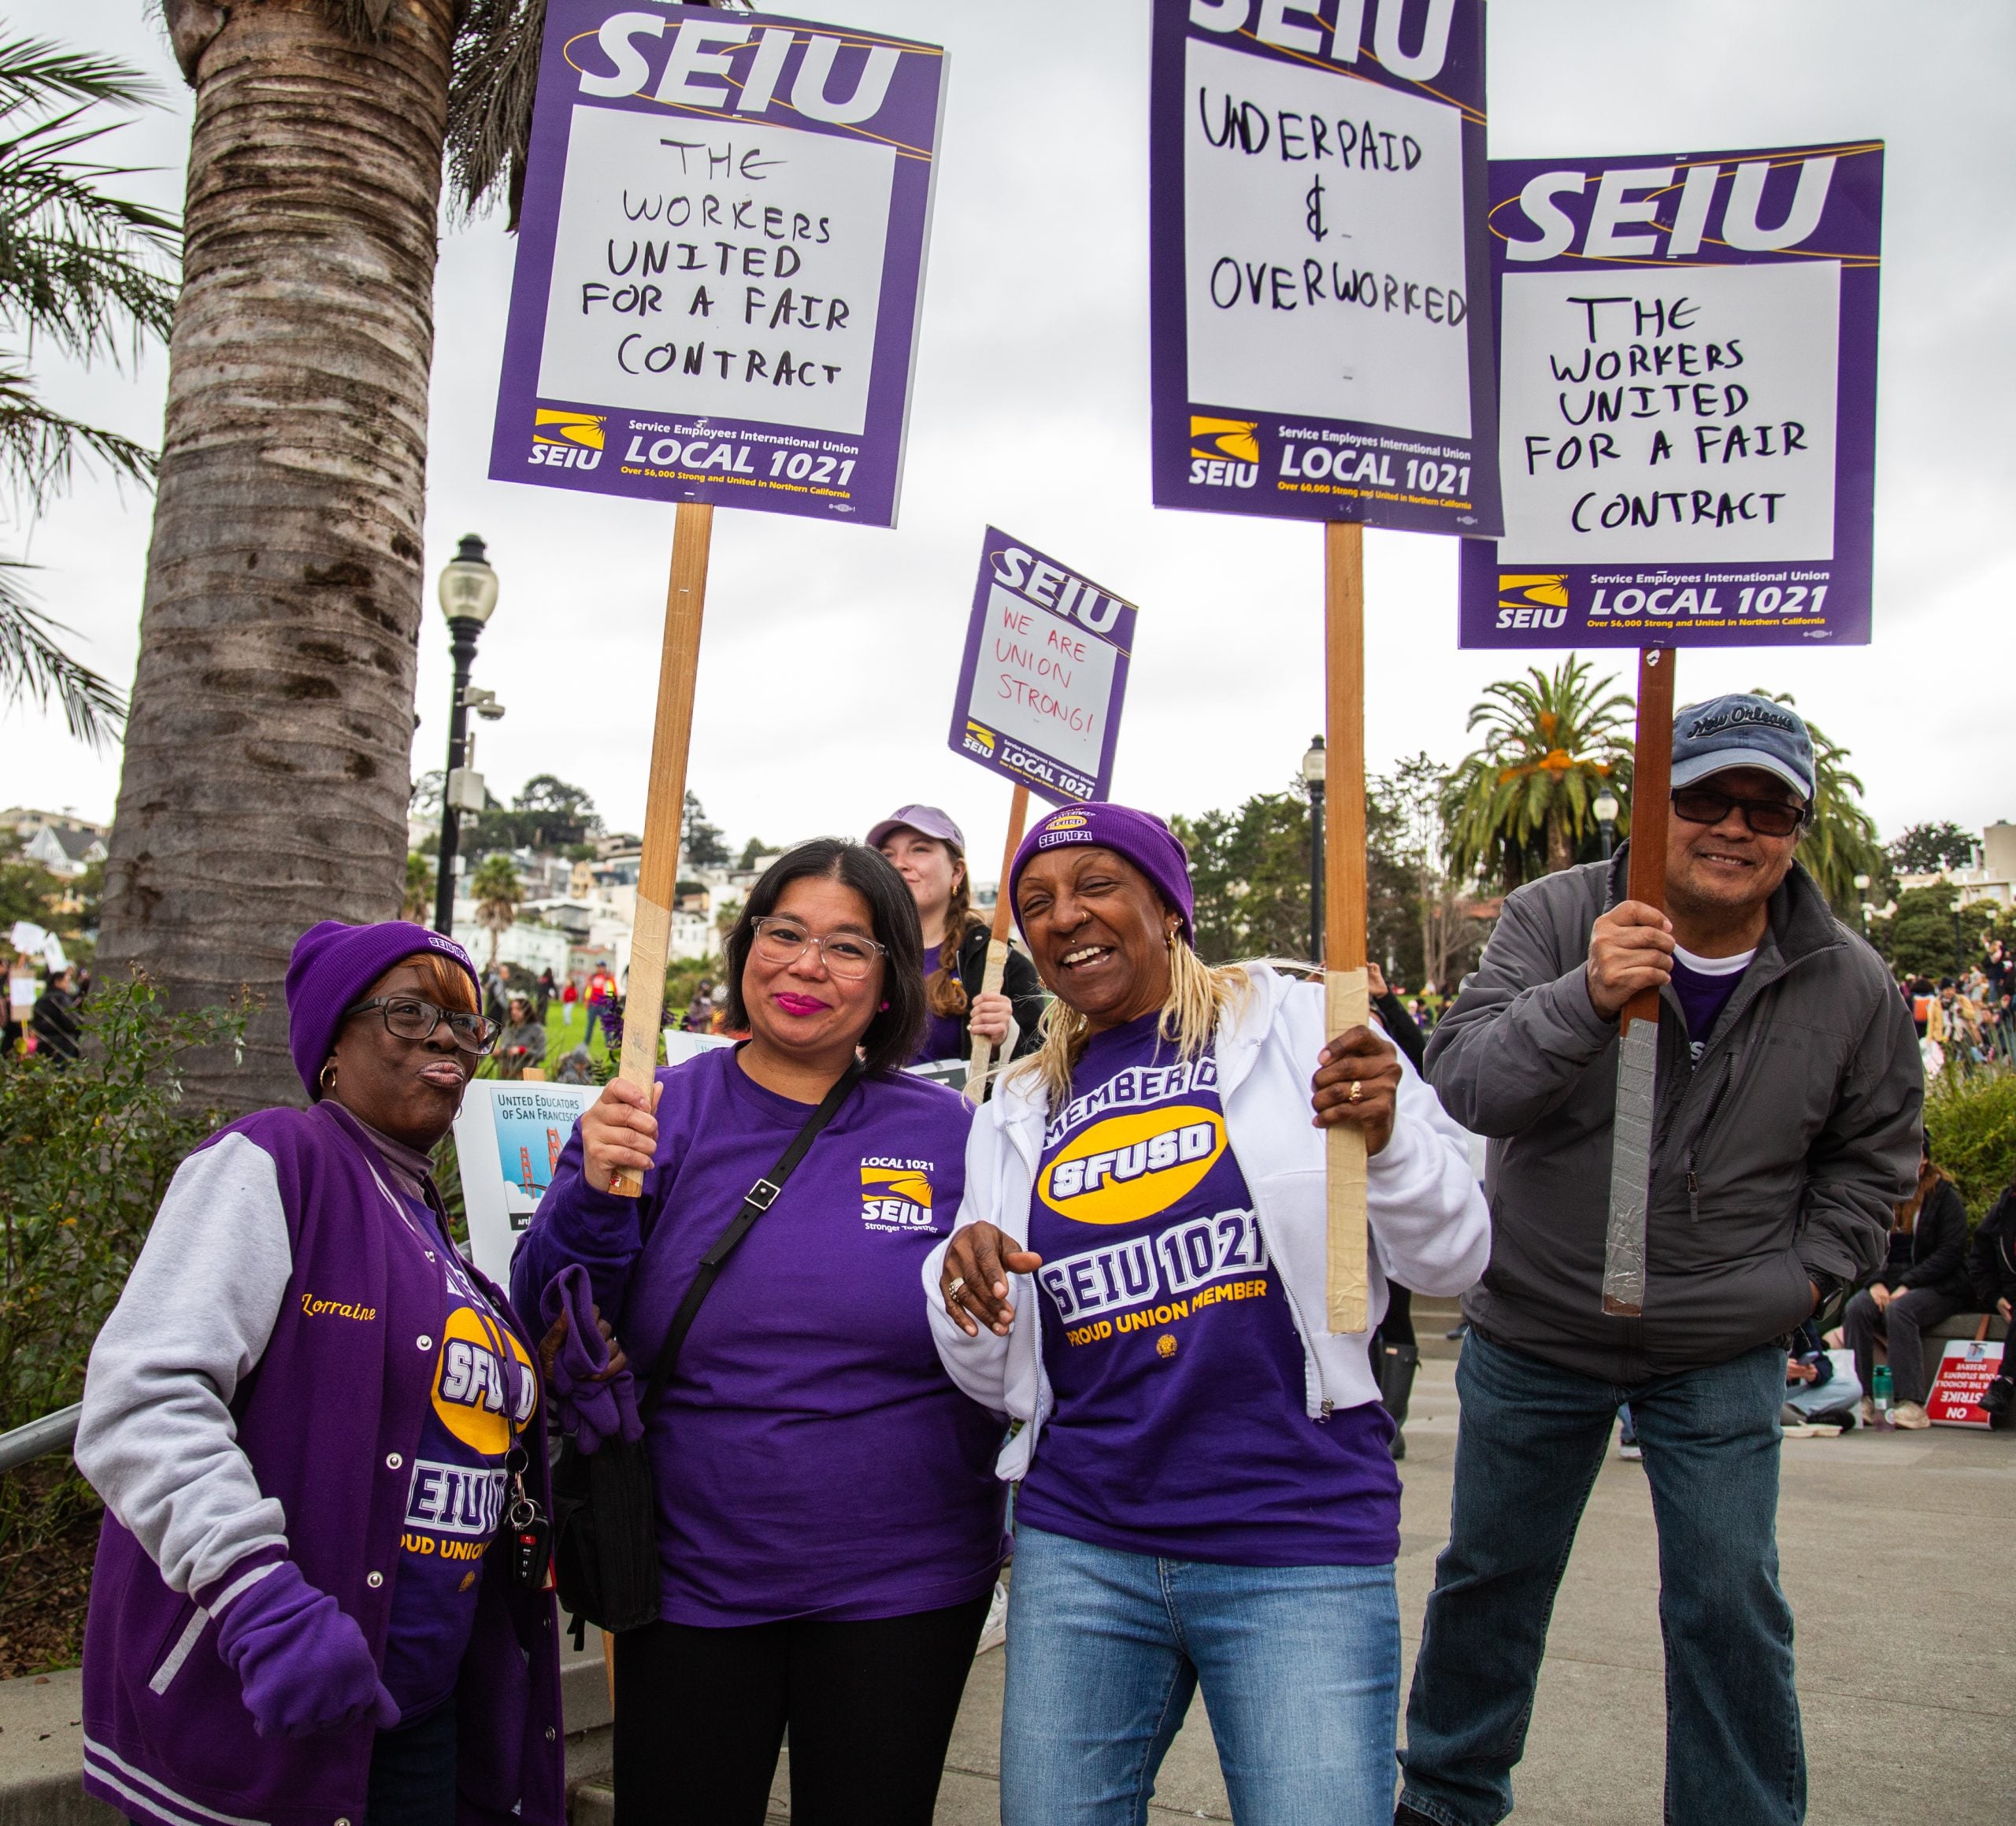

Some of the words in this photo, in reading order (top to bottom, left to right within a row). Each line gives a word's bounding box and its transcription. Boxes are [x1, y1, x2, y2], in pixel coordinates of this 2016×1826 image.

[578, 12, 901, 124] SEIU
[1200, 87, 1421, 171] UNDERPAID
[660, 138, 789, 180] THE
[624, 189, 829, 243] WORKERS
[1506, 156, 1837, 261] SEIU
[607, 239, 800, 278] UNITED
[582, 282, 662, 317] FOR
[688, 284, 714, 317] A
[745, 287, 850, 331] FAIR
[1211, 257, 1467, 326] OVERWORKED
[1566, 296, 1701, 343] THE
[618, 333, 842, 387] CONTRACT
[1550, 339, 1744, 383] WORKERS
[1559, 383, 1749, 425] UNITED
[528, 444, 602, 470] SEIU
[629, 420, 670, 433] Service
[674, 424, 737, 439] Employees
[740, 431, 819, 449] International
[822, 442, 859, 455] Union
[1278, 425, 1319, 440] Service
[1322, 430, 1378, 447] Employees
[1380, 437, 1440, 456] International
[1443, 446, 1471, 461] Union
[1525, 431, 1621, 475] FOR
[1649, 430, 1673, 465] A
[1694, 421, 1808, 465] FAIR
[624, 435, 756, 473] LOCAL
[769, 450, 856, 486] 1021
[1188, 458, 1258, 488] SEIU
[1279, 444, 1395, 487] LOCAL
[1406, 459, 1470, 495] 1021
[621, 466, 642, 476] Over
[644, 468, 675, 479] 56,000
[677, 472, 705, 483] Strong
[707, 475, 724, 483] and
[727, 476, 756, 487] United
[758, 480, 767, 488] in
[769, 481, 807, 493] Northern
[810, 486, 850, 498] California
[1277, 481, 1299, 491] Over
[1300, 483, 1330, 494] 60,000
[1332, 486, 1358, 498] Strong
[1360, 490, 1373, 498] and
[1375, 490, 1399, 502] United
[1400, 493, 1408, 502] in
[1409, 494, 1439, 506] Northern
[1440, 498, 1472, 509] California
[1572, 491, 1785, 533] CONTRACT
[995, 547, 1122, 632] SEIU
[1591, 574, 1632, 584] Service
[1636, 573, 1701, 585] Employees
[1704, 572, 1786, 583] International
[1790, 572, 1829, 581] Union
[1496, 608, 1567, 629] SEIU
[1589, 588, 1722, 615] LOCAL
[1737, 586, 1828, 614] 1021
[1003, 606, 1034, 636] WE
[1047, 629, 1087, 663] ARE
[1610, 620, 1642, 628] 56,000
[1644, 620, 1673, 628] Strong
[996, 638, 1071, 688] UNION
[997, 673, 1094, 742] STRONG!
[1688, 713, 1729, 738] New
[1731, 706, 1796, 733] Orleans
[962, 737, 994, 758] SEIU
[1004, 739, 1021, 751] Service
[1049, 760, 1080, 780] International
[1080, 775, 1095, 787] Union
[1001, 747, 1054, 783] LOCAL
[1058, 775, 1094, 800] 1021
[1040, 832, 1065, 848] SEIU
[1066, 830, 1092, 842] 1021
[428, 937, 454, 953] SEIU
[498, 1094, 533, 1106] UNITED
[536, 1094, 580, 1109] EDUCATORS
[516, 1108, 535, 1120] SAN
[1042, 1062, 1194, 1150] MEMBER
[861, 1157, 903, 1169] LOCAL
[906, 1160, 934, 1171] 1021
[1049, 1121, 1216, 1202] SFUSD
[862, 1200, 932, 1224] SEIU
[865, 1222, 899, 1233] Stronger
[1039, 1235, 1159, 1324] SEIU
[1157, 1208, 1269, 1294] 1021
[302, 1294, 376, 1320] Lorraine
[1065, 1320, 1112, 1347] PROUD
[1117, 1302, 1188, 1334] UNION
[1191, 1280, 1267, 1313] MEMBER
[442, 1340, 536, 1420] SFUD
[1941, 1391, 1984, 1403] STRIKE
[1947, 1407, 1967, 1419] ON
